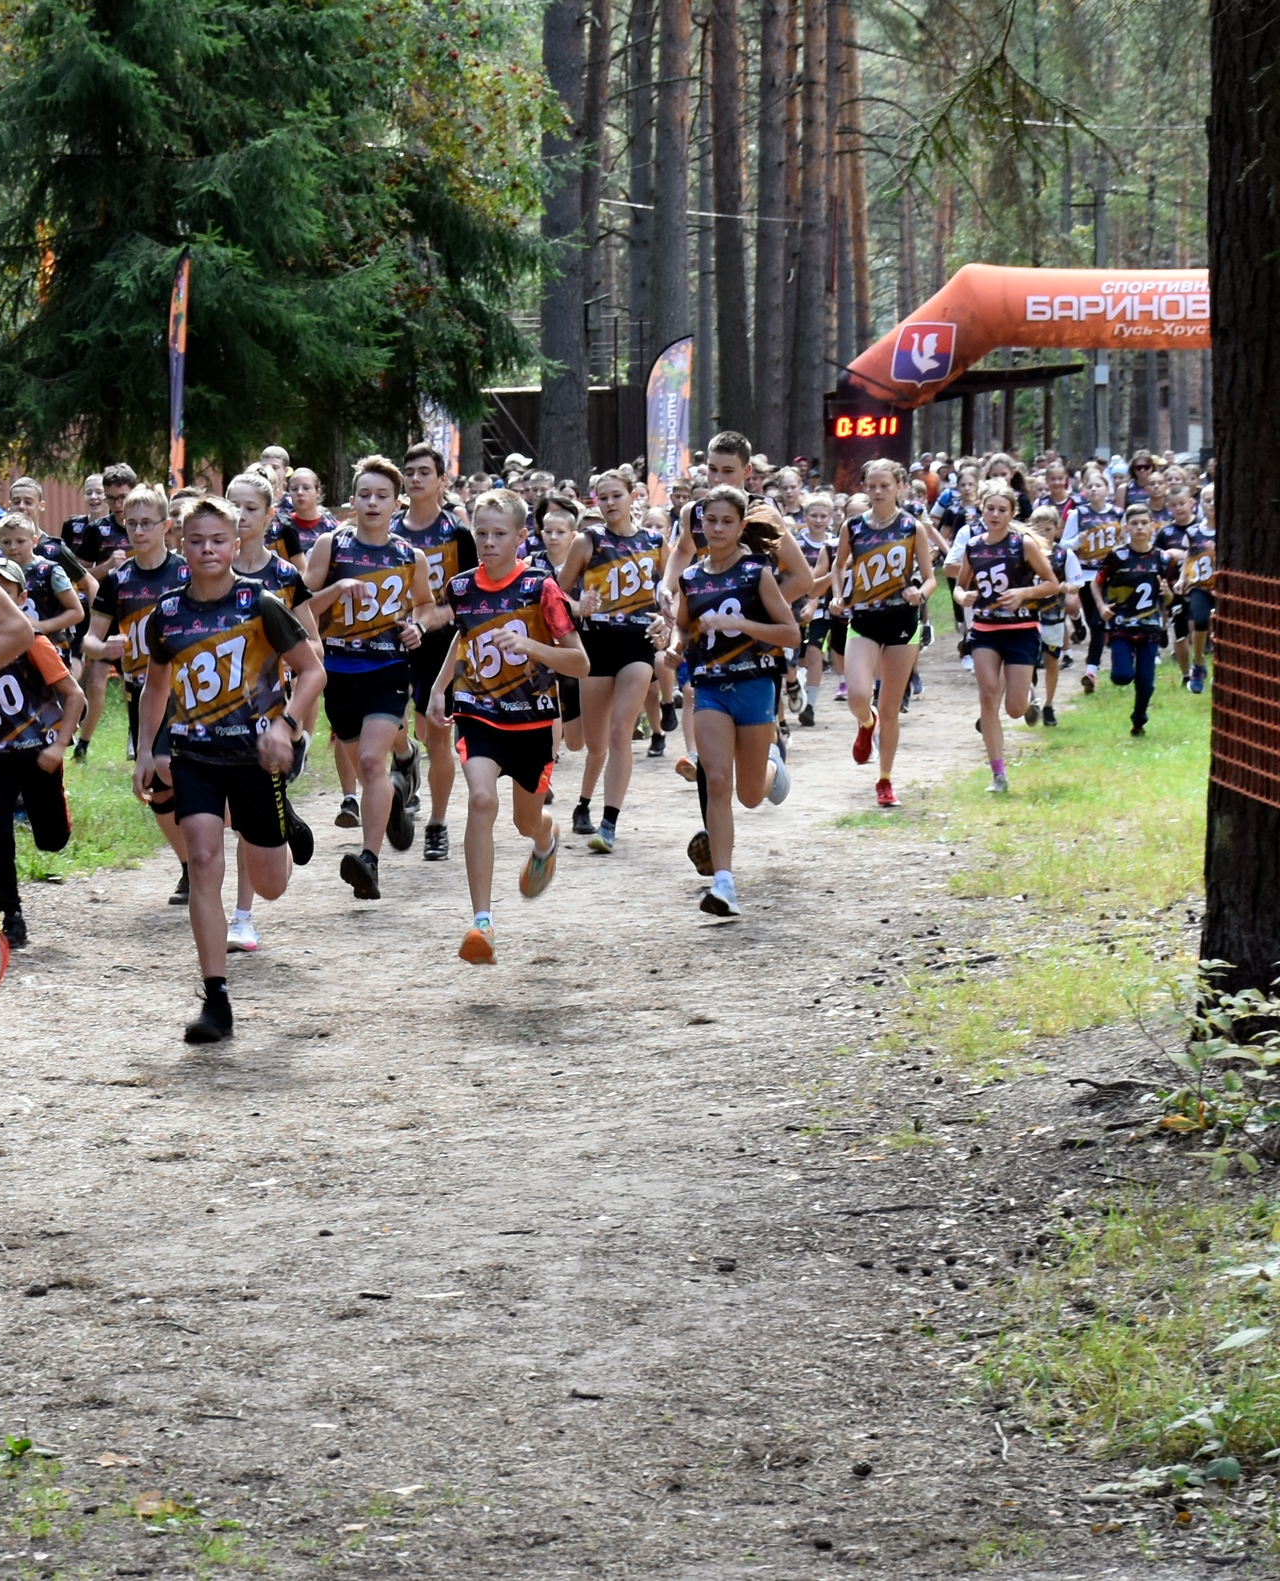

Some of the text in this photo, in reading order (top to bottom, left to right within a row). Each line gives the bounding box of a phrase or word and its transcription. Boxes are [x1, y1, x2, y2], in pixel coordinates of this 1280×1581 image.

[1100, 280, 1210, 294] СПОРТИВН
[1026, 294, 1210, 322] БАРИНОВ
[1113, 323, 1210, 338] Гусь-Хрус
[836, 417, 897, 437] 0:15:11
[1087, 525, 1116, 552] 113
[605, 556, 655, 601] 133
[858, 545, 907, 592] 129
[338, 575, 404, 627] 132
[1135, 582, 1153, 610] 2
[175, 635, 247, 710] 137
